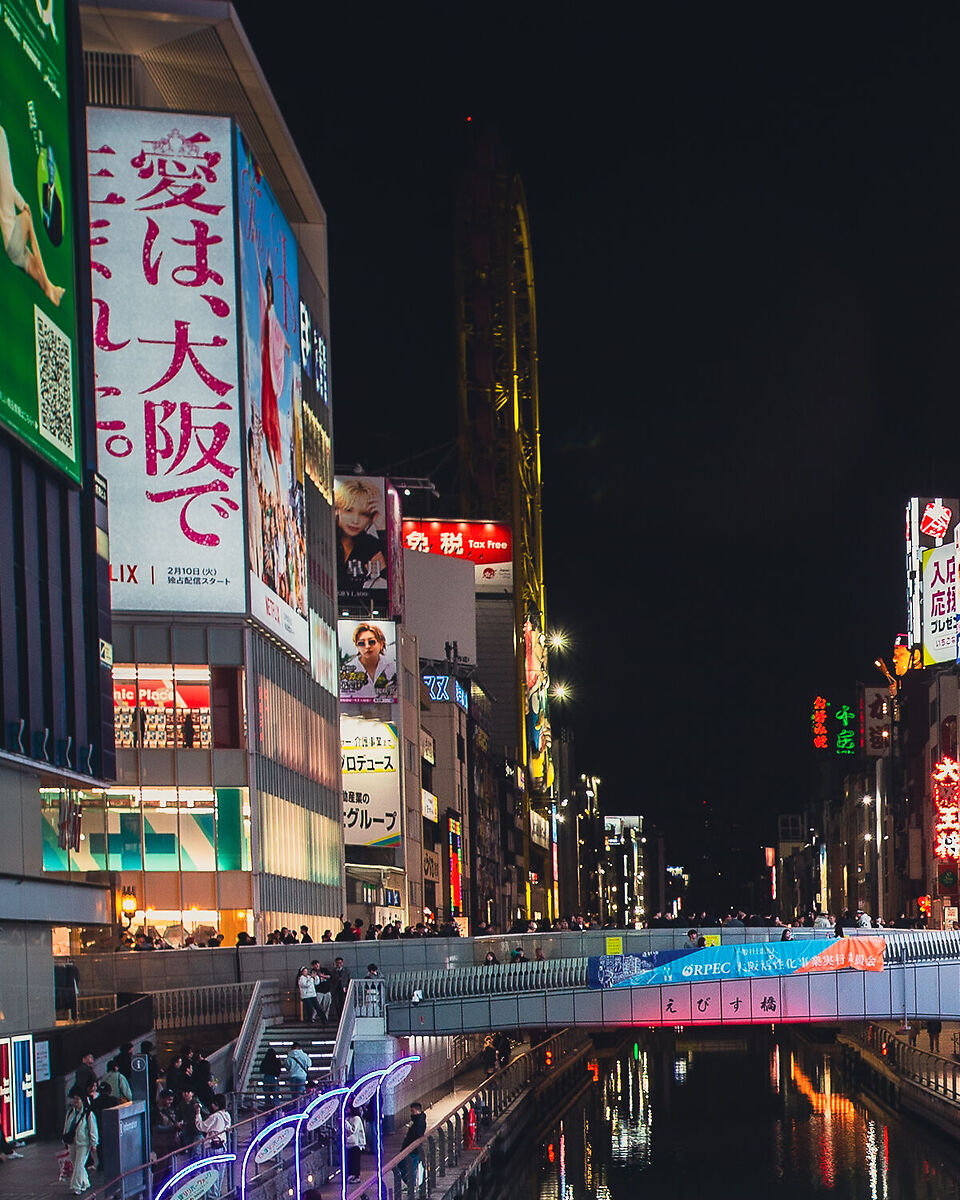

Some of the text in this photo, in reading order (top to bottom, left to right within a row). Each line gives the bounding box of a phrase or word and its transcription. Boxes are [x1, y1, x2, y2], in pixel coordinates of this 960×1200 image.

[131, 128, 241, 548] 愛は、大阪で
[406, 531, 463, 555] 免税
[468, 539, 507, 549] Tax Free
